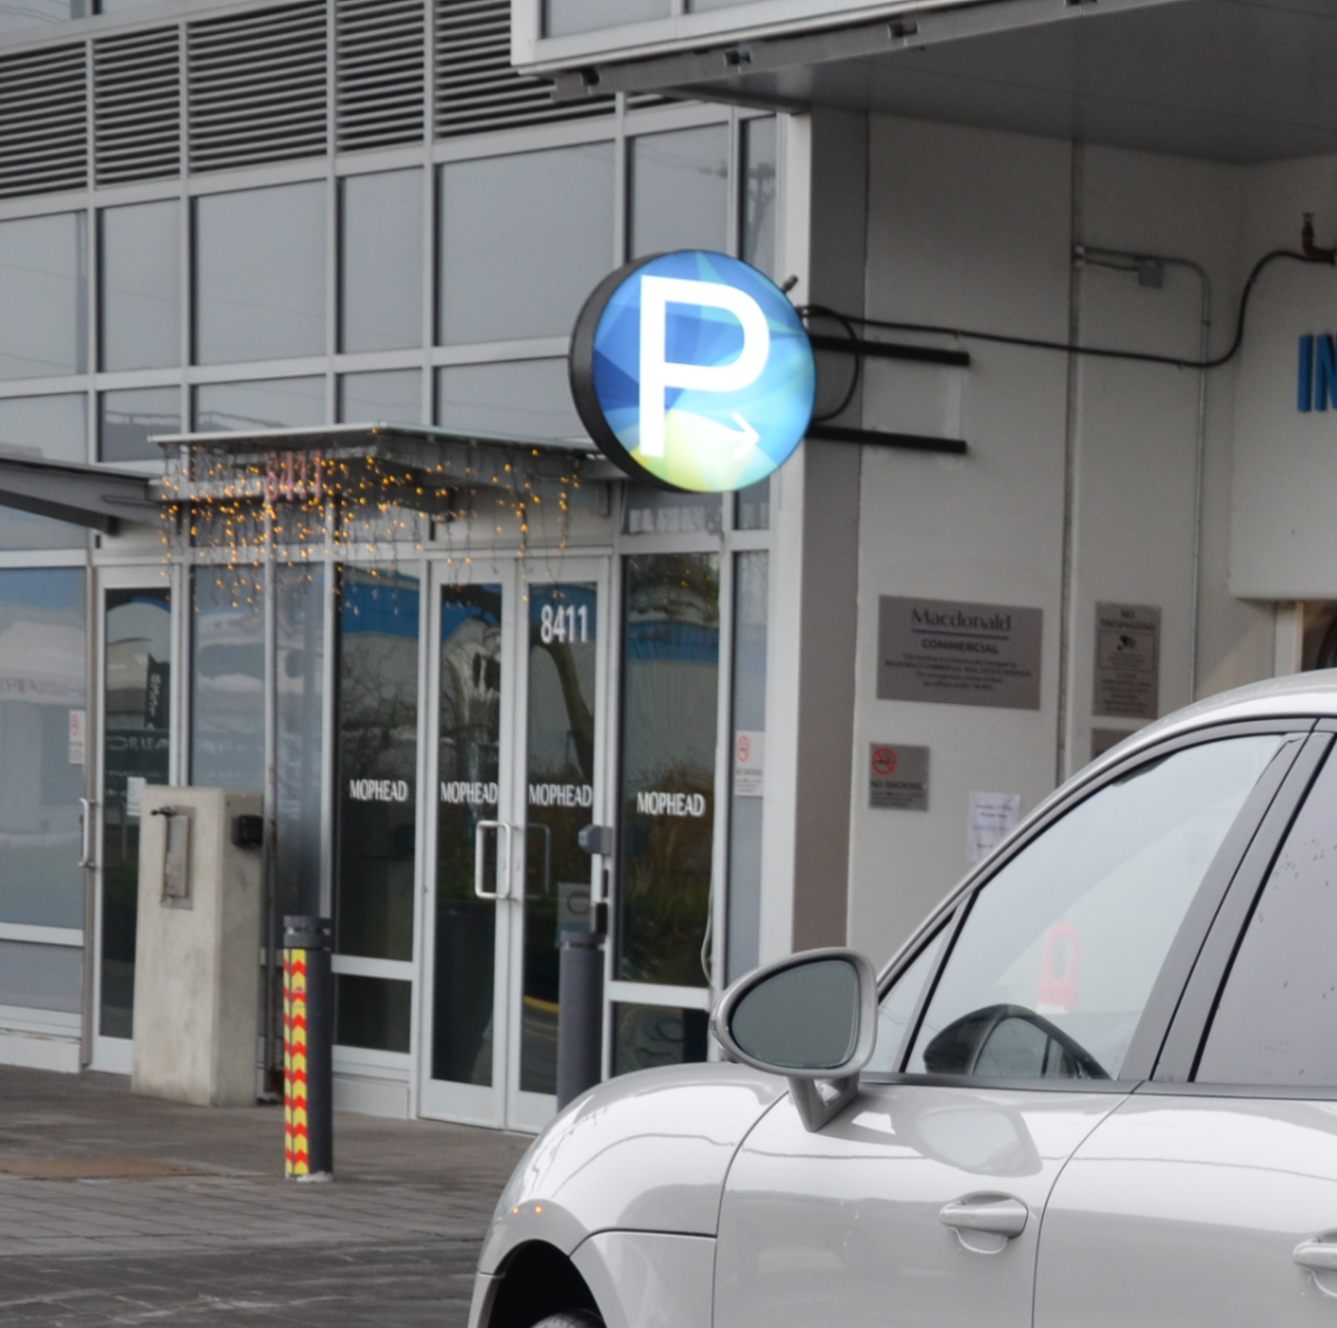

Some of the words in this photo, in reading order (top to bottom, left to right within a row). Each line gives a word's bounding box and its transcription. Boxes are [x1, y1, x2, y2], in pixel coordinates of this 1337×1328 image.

[639, 274, 770, 459] P
[540, 604, 588, 644] 8411
[911, 607, 1012, 631] Macdonald
[921, 638, 999, 654] COMMERCIAL
[350, 779, 408, 801] MOPHEAD
[441, 781, 499, 803] MOPHEAD
[529, 784, 592, 806] MOPHEAD
[637, 791, 706, 816] MOPHEAD
